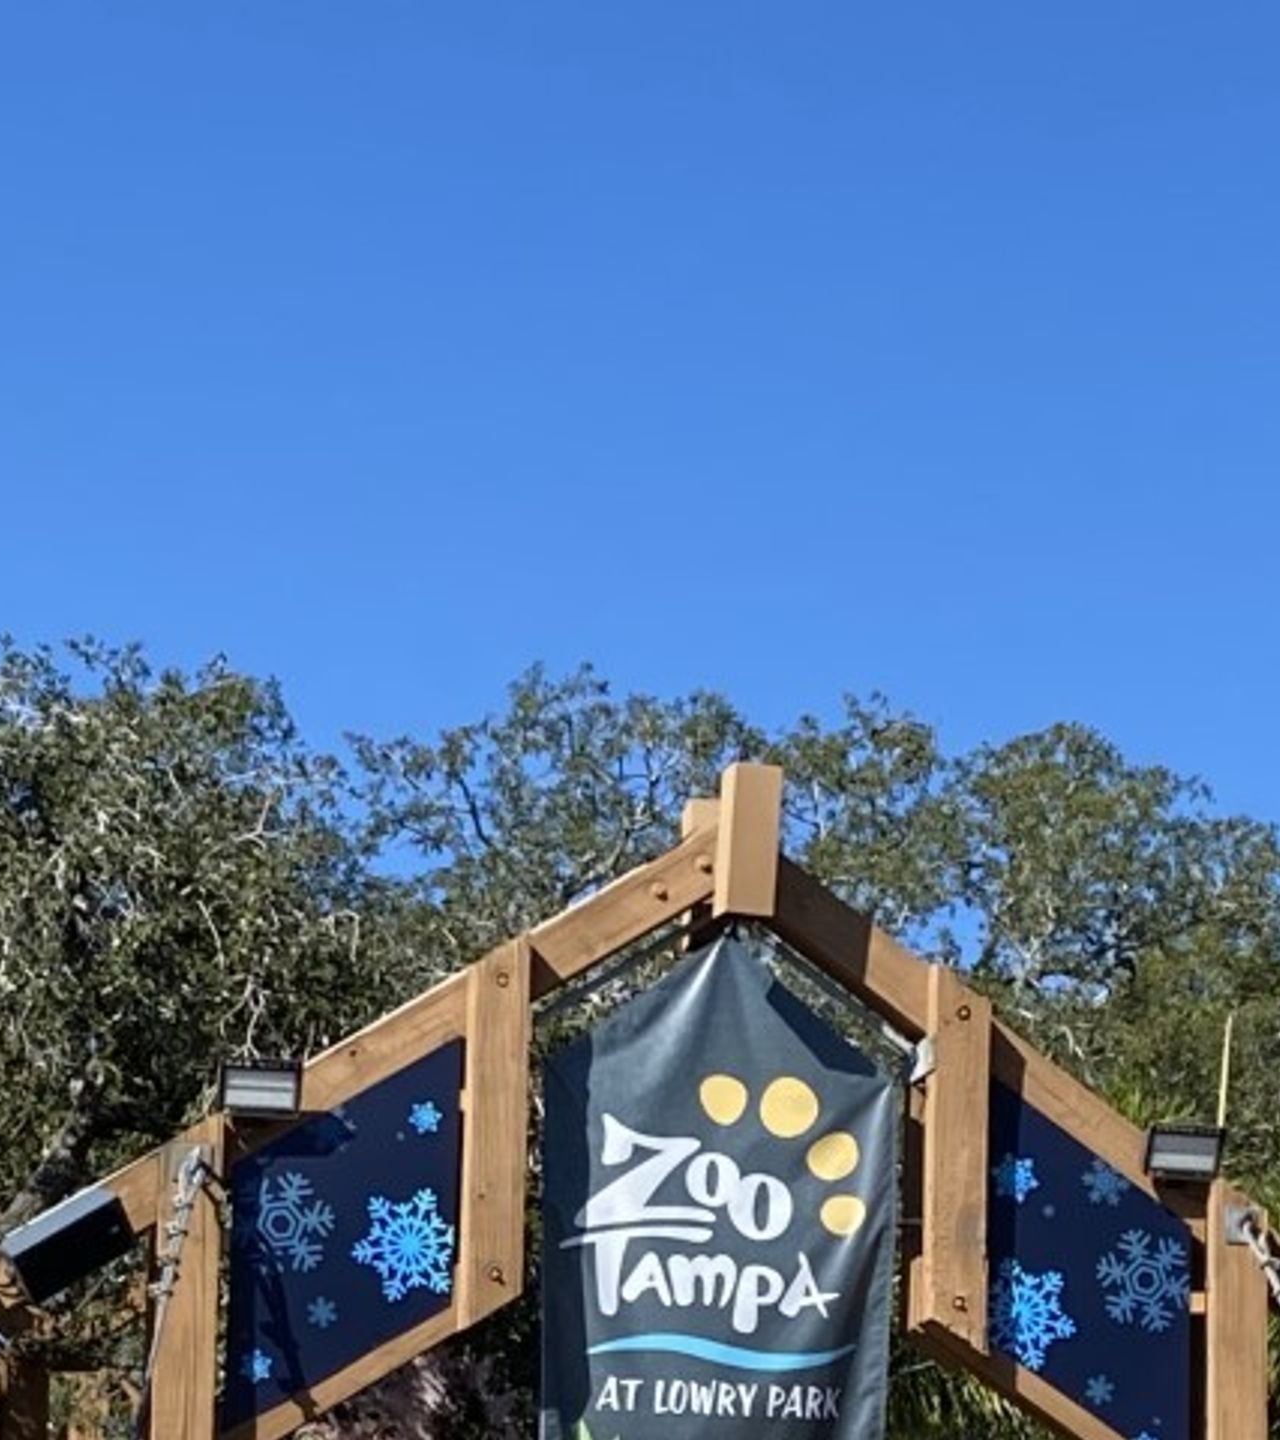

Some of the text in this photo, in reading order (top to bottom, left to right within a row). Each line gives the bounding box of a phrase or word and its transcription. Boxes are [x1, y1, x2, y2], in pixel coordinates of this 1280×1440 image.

[596, 1377, 841, 1421] AT LOWRY PARK
